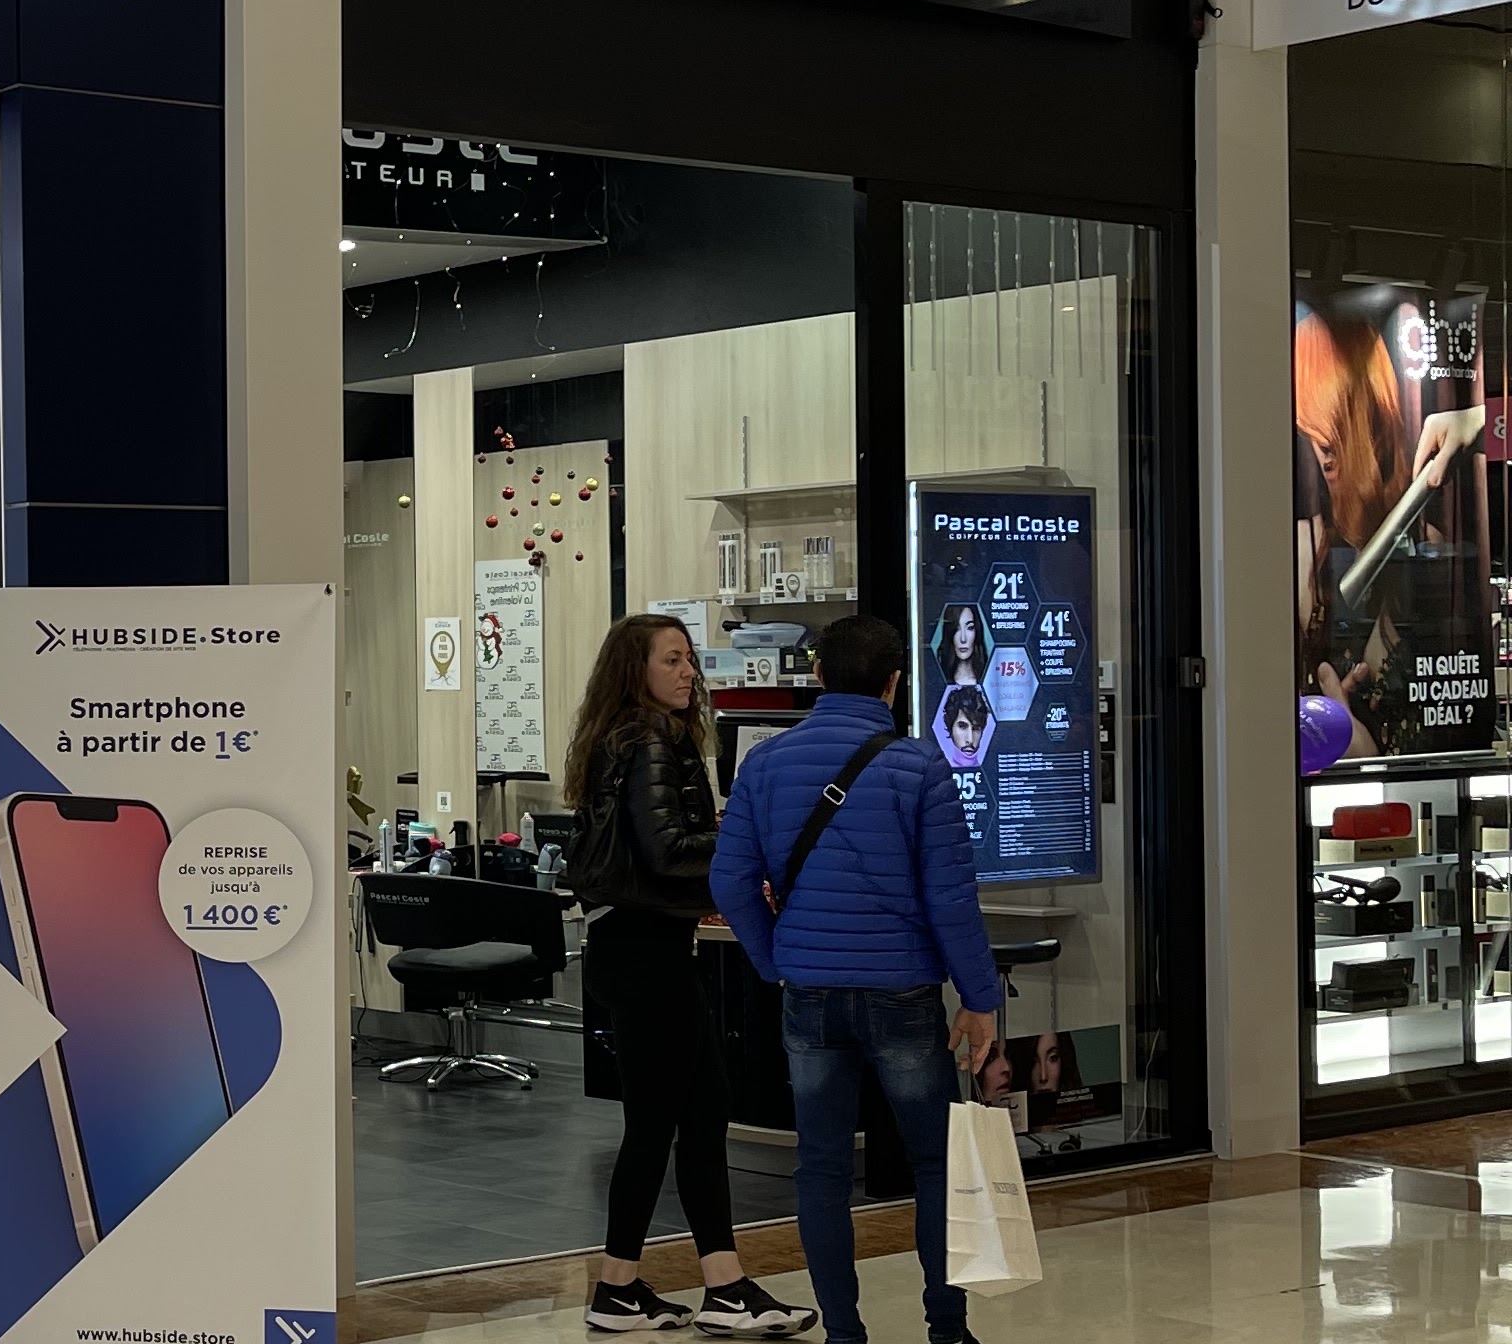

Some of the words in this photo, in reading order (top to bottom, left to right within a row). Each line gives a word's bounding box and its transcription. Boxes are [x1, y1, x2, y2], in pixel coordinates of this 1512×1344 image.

[1399, 299, 1478, 380] ghd
[934, 514, 1010, 532] Pascal
[1017, 515, 1080, 533] Coste
[353, 532, 390, 544] Coste
[995, 661, 1027, 677] -15%
[1416, 657, 1433, 676] EN
[1436, 650, 1479, 676] QUÊTE
[1409, 682, 1427, 702] DU
[1430, 679, 1488, 701] CADEAU
[70, 696, 246, 723] Smartphone
[1424, 701, 1463, 726] IDÉAL
[1465, 704, 1474, 723] ?
[56, 730, 72, 753] à
[82, 730, 161, 757] partir
[170, 731, 206, 753] de
[204, 847, 268, 858] REPRISE
[178, 864, 196, 875] de
[201, 865, 225, 875] vos
[229, 864, 293, 877] appareils
[210, 881, 261, 895] jusqu'à
[370, 892, 400, 901] Pascal
[402, 895, 430, 903] Coste
